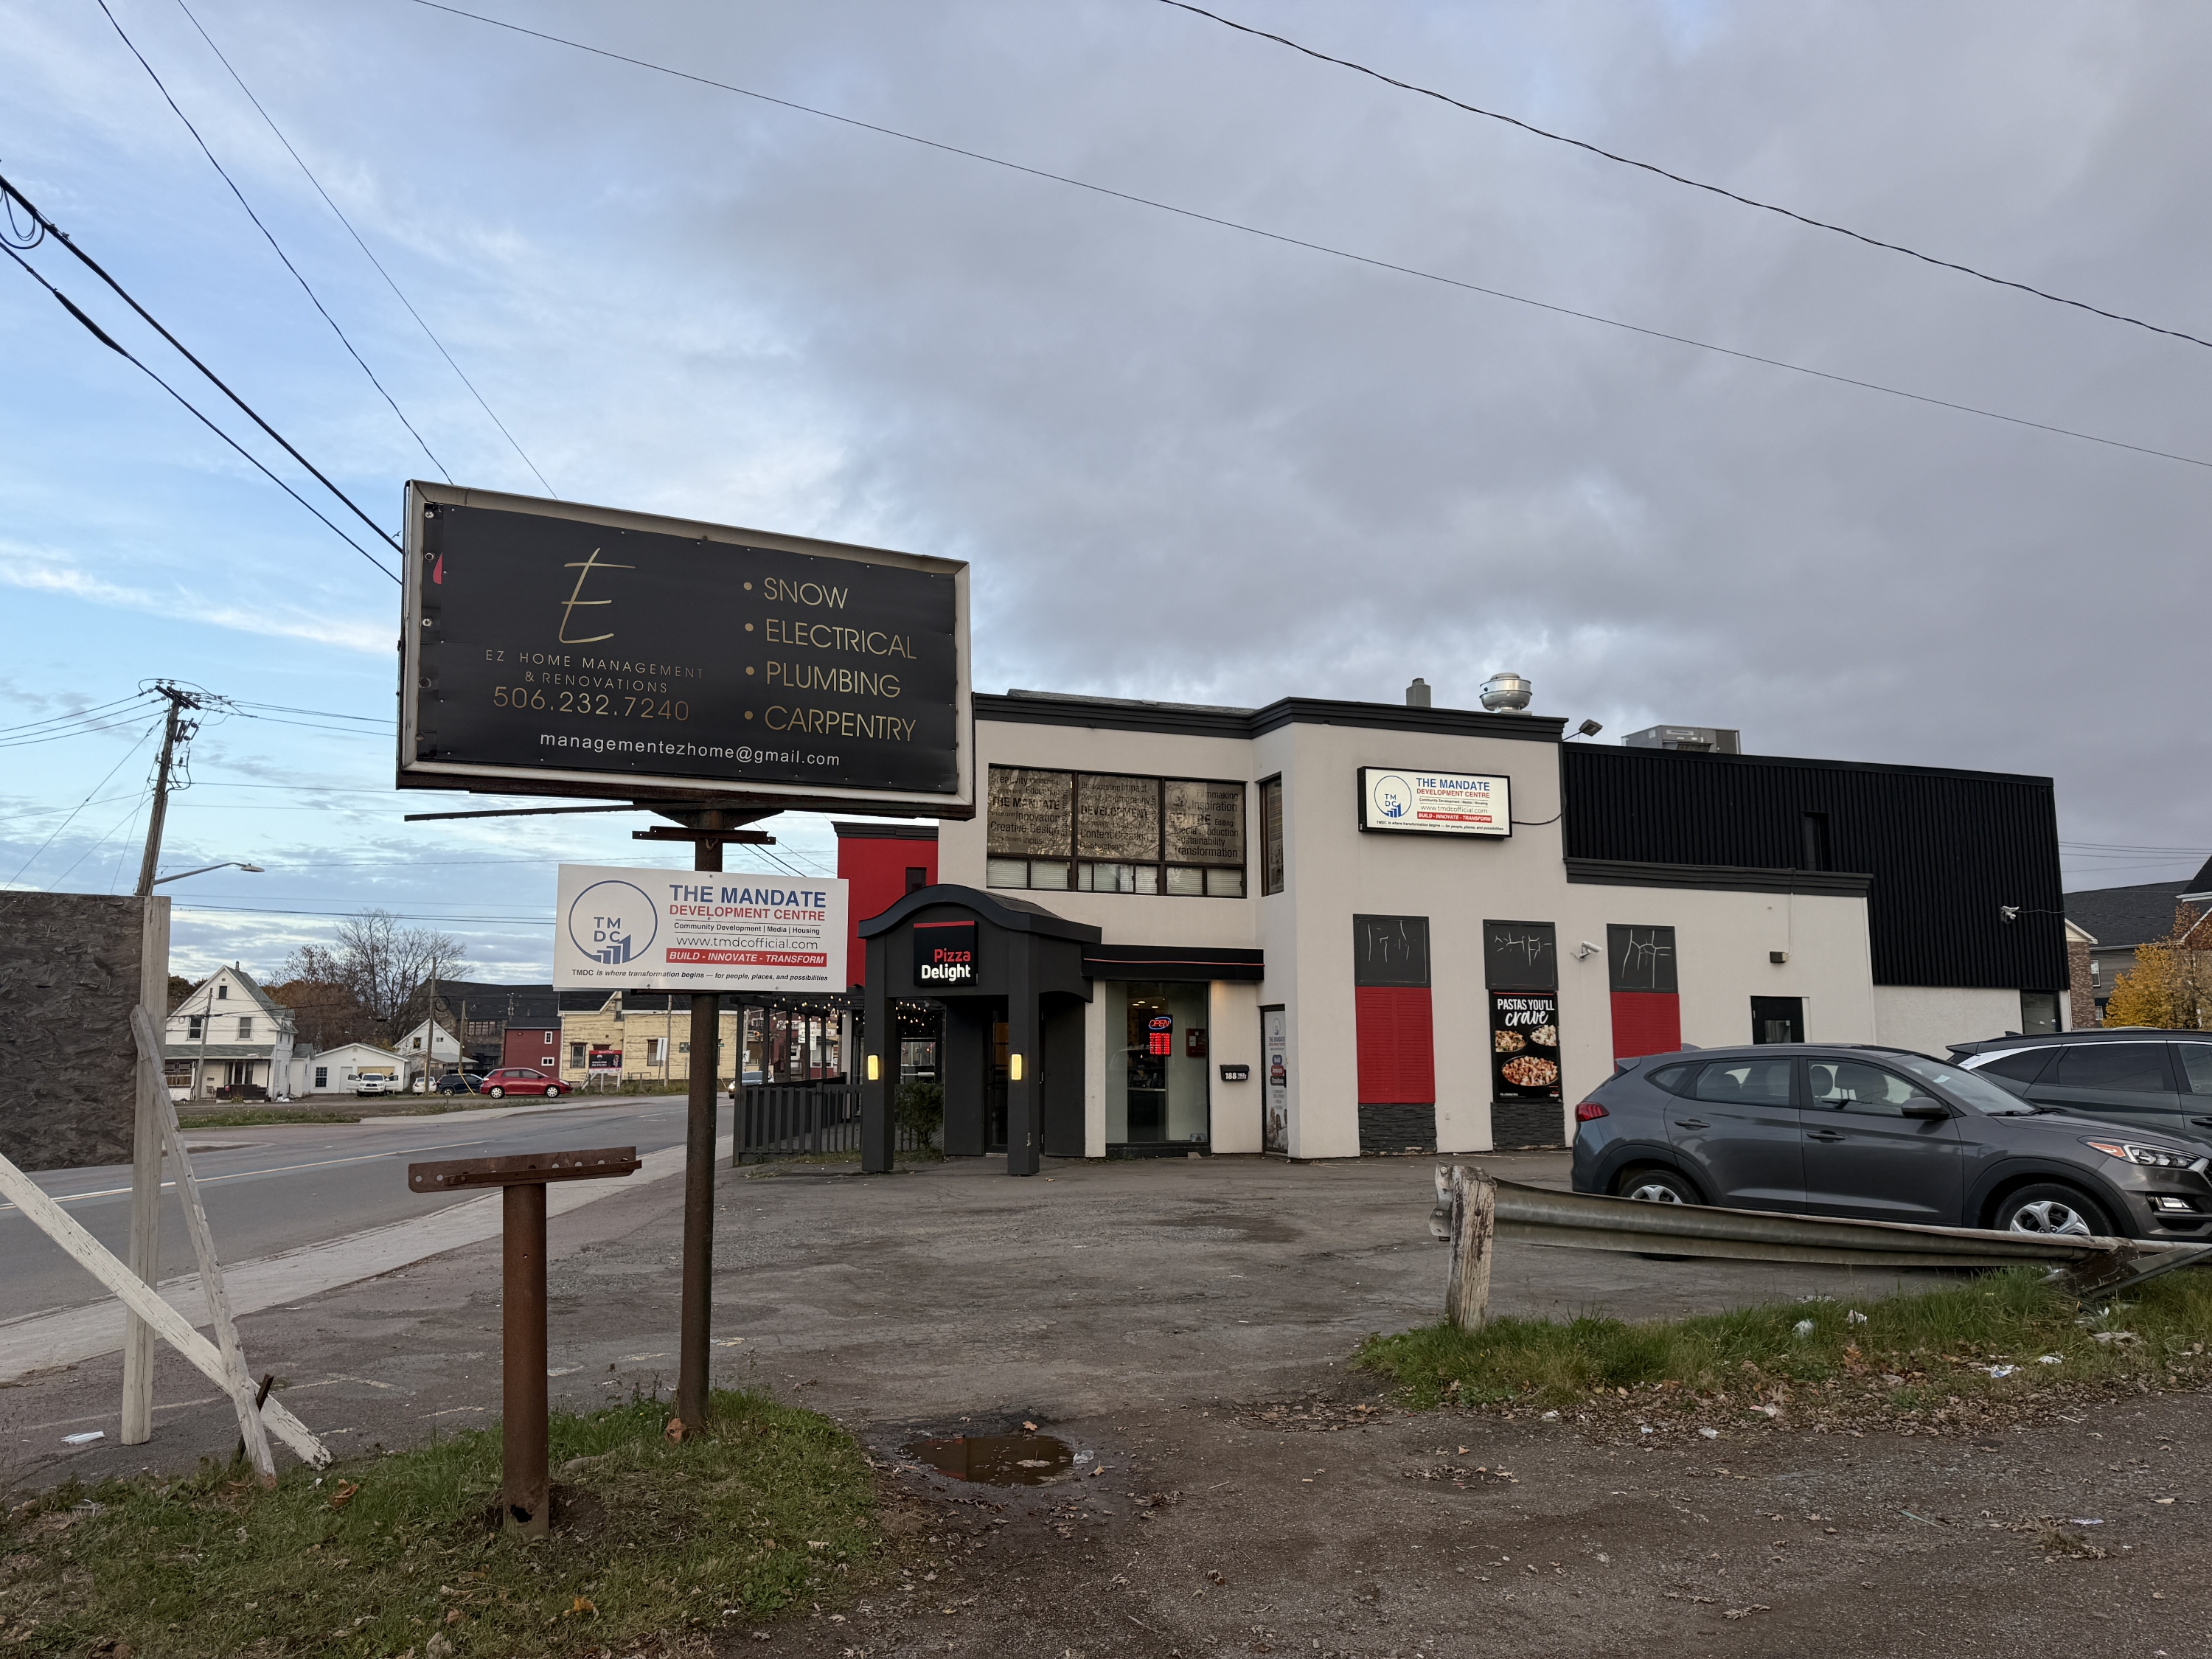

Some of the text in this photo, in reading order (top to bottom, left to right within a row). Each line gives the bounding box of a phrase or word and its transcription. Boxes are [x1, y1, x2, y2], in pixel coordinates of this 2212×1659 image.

[558, 547, 636, 644] E
[764, 577, 848, 609] SNOW
[766, 618, 917, 659] ELECTRICAL
[486, 650, 703, 678] EZ HOME MANAGEMENT
[525, 671, 667, 693] & RENOVATIONS
[767, 661, 901, 698] PLUMBING
[493, 686, 689, 721] 506.232.7240
[765, 705, 917, 742] CARPENTRY
[540, 733, 841, 766] managementezhome@gmail.com
[991, 775, 1028, 786] Creavity
[1121, 782, 1147, 793] Impact
[1416, 777, 1490, 791] THE MANDATE
[1197, 789, 1238, 801] Filmmaking
[1416, 788, 1463, 797] DEVELOPMENT
[1192, 800, 1237, 812] Inspiration
[1016, 811, 1060, 822] Innovation
[1214, 818, 1234, 827] Editing
[990, 821, 1060, 835] Creative Design
[1080, 829, 1113, 839] Content
[1200, 827, 1238, 837] Poduction
[1023, 836, 1056, 846] Inclusity
[1176, 835, 1225, 847] Sustainability
[1175, 846, 1237, 858] Transformation
[669, 884, 826, 908] THE MANDATE
[669, 904, 825, 921] DEVELOPMENT CENTRE
[594, 917, 621, 929] TM
[674, 922, 714, 931] Community
[717, 924, 761, 933] Development
[793, 927, 820, 936] Housing
[594, 930, 621, 942] DC
[676, 936, 818, 950] www.tmdcofficial.com
[669, 951, 700, 960] BUILD
[708, 953, 757, 961] INNOVATE
[766, 954, 824, 964] TRANSFORM
[934, 948, 971, 962] Pizza
[921, 963, 971, 981] Delight
[1497, 998, 1554, 1011] PASTAS YOU'LL
[1150, 1019, 1169, 1027] OPEN
[1505, 1010, 1548, 1026] crave
